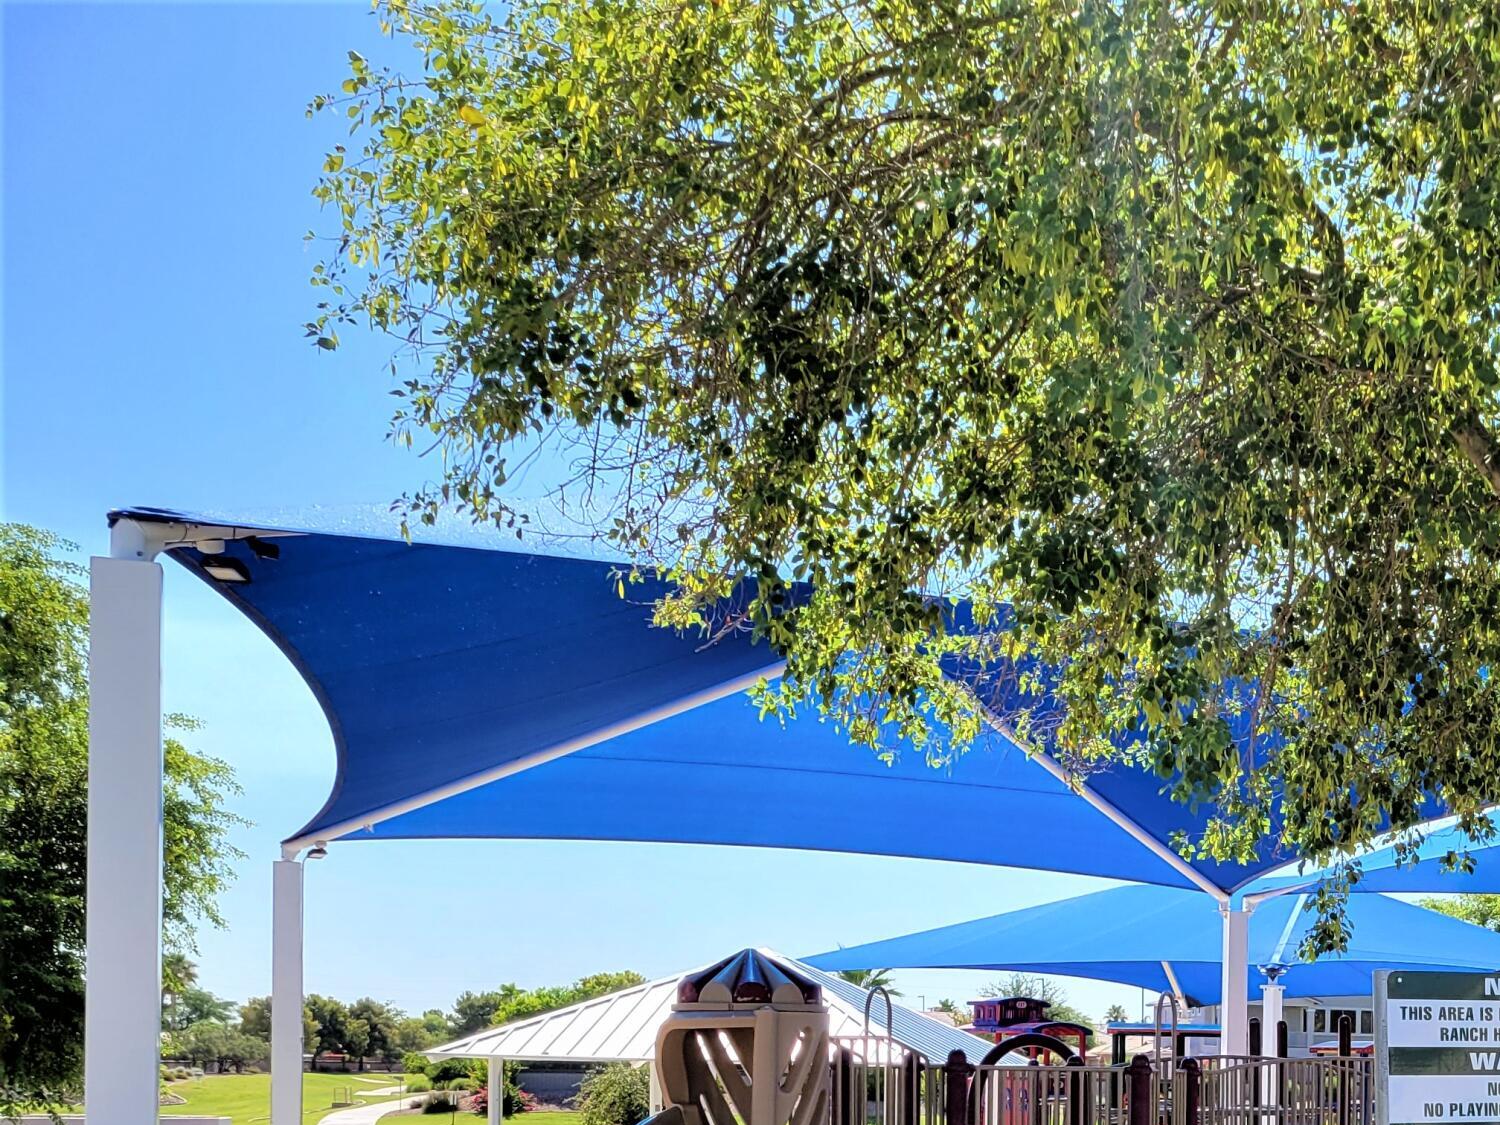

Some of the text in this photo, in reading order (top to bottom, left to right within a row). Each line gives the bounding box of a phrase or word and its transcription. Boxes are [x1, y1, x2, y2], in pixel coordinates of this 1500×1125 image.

[1400, 1006, 1432, 1021] THIS
[1438, 1007, 1474, 1021] AREA
[1480, 1008, 1493, 1021] IS
[1440, 1027, 1488, 1042] RANCH
[1424, 1103, 1443, 1117] NO
